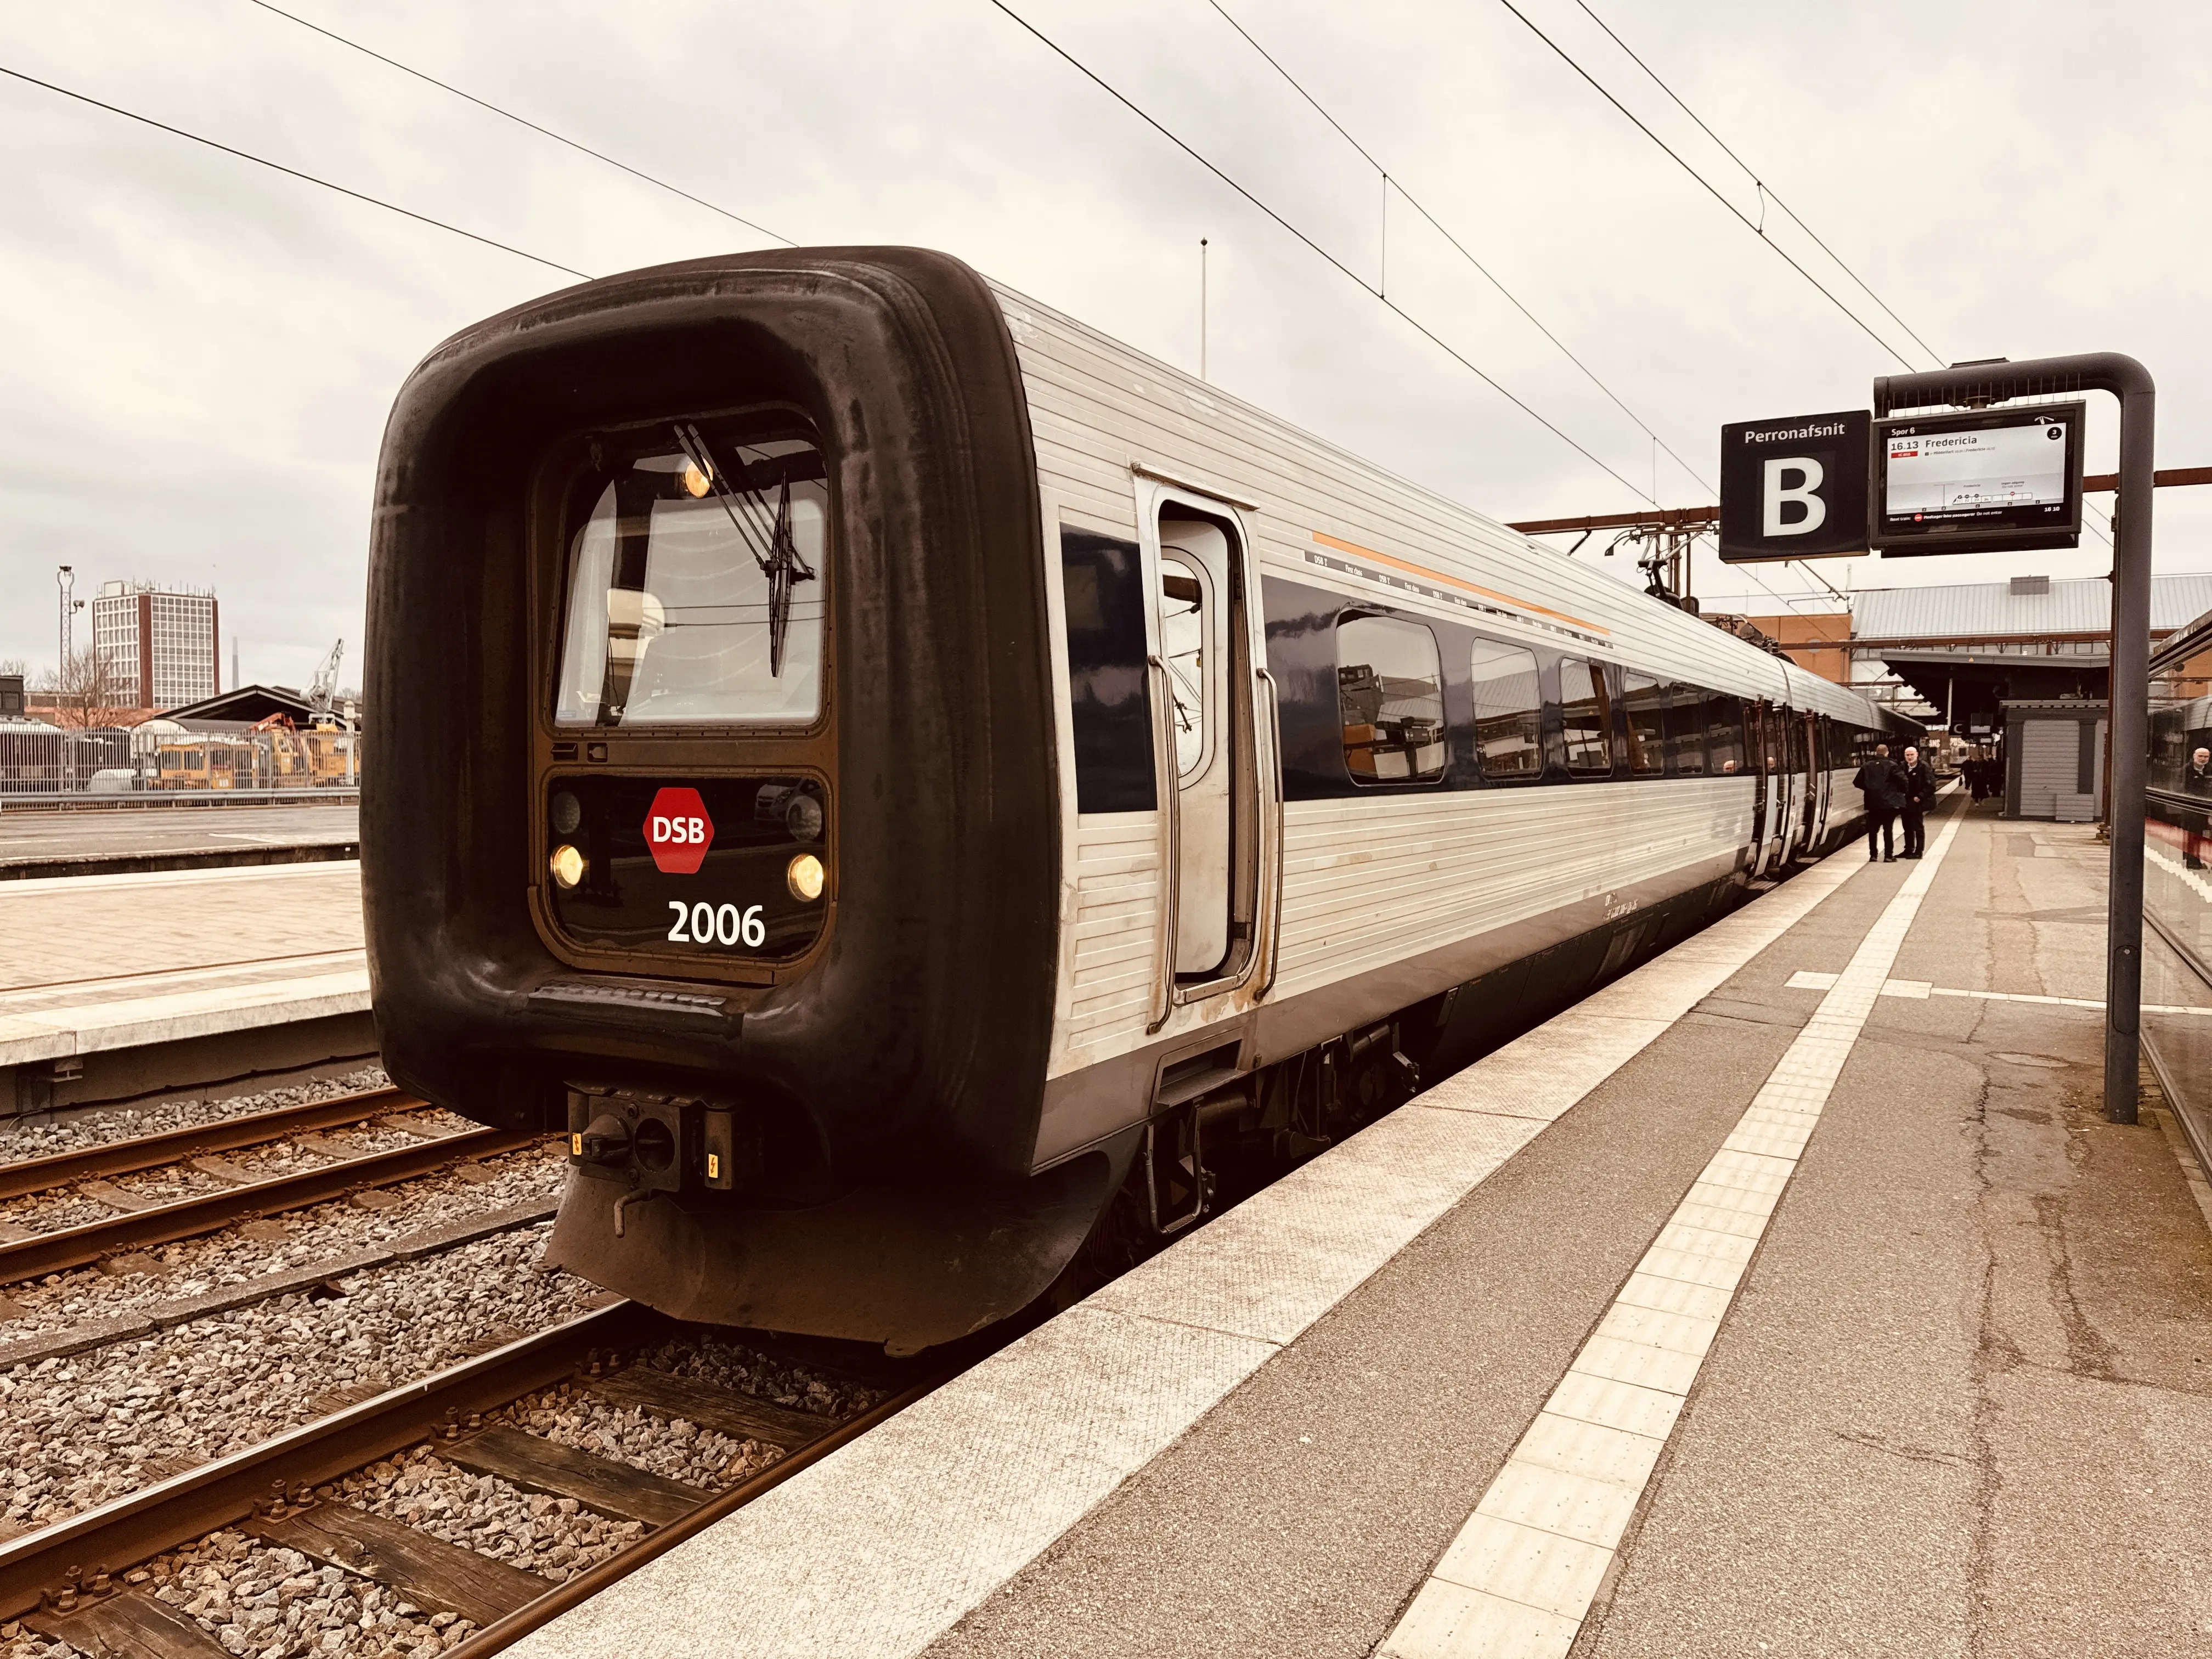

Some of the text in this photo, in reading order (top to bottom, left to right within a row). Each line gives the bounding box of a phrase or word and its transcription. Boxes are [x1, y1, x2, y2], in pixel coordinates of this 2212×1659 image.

[1745, 422, 1846, 444] Perronafsnit
[1891, 428, 1908, 437] Spor
[1891, 436, 1978, 451] 16.13 Fredericia
[1763, 456, 1826, 537] B
[1314, 555, 1324, 565] DSB
[1345, 564, 1354, 574] First
[1354, 567, 1363, 577] class
[1953, 723, 1963, 733] C
[652, 816, 705, 844] DSB
[667, 901, 766, 947] 2006
